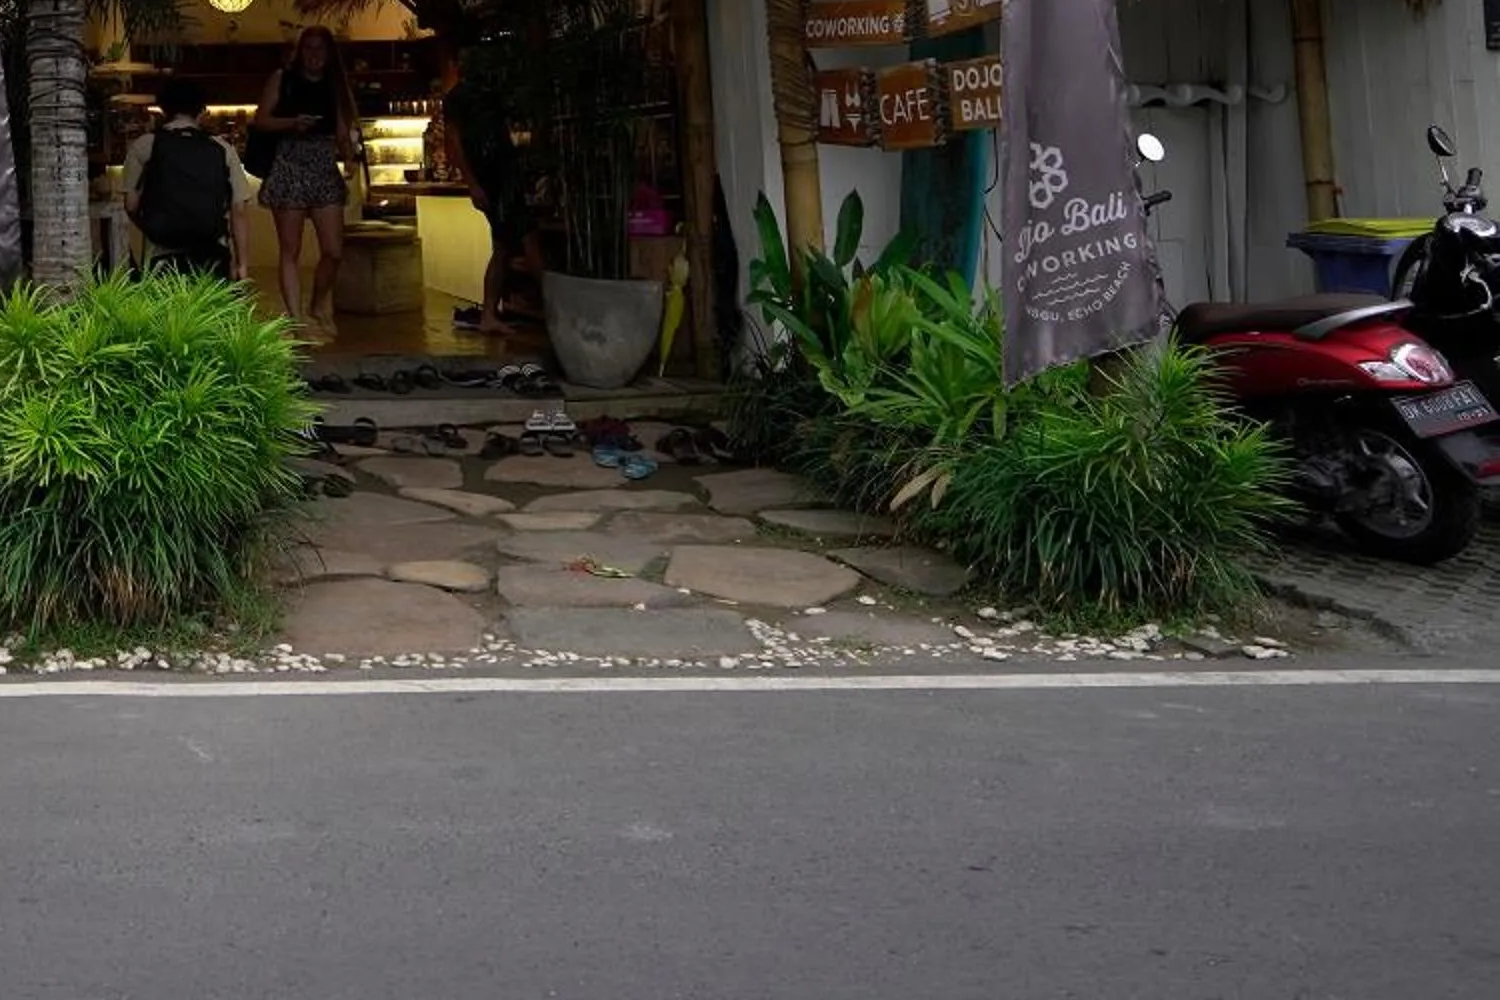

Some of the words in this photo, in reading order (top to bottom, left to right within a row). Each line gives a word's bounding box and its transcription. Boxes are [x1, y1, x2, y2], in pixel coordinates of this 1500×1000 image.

[805, 15, 889, 39] COWORKING
[953, 63, 1003, 92] DOJO
[879, 88, 929, 127] CAFE
[961, 95, 1003, 122] BALI
[1060, 191, 1128, 236] Bali
[1103, 260, 1132, 303] BEACH
